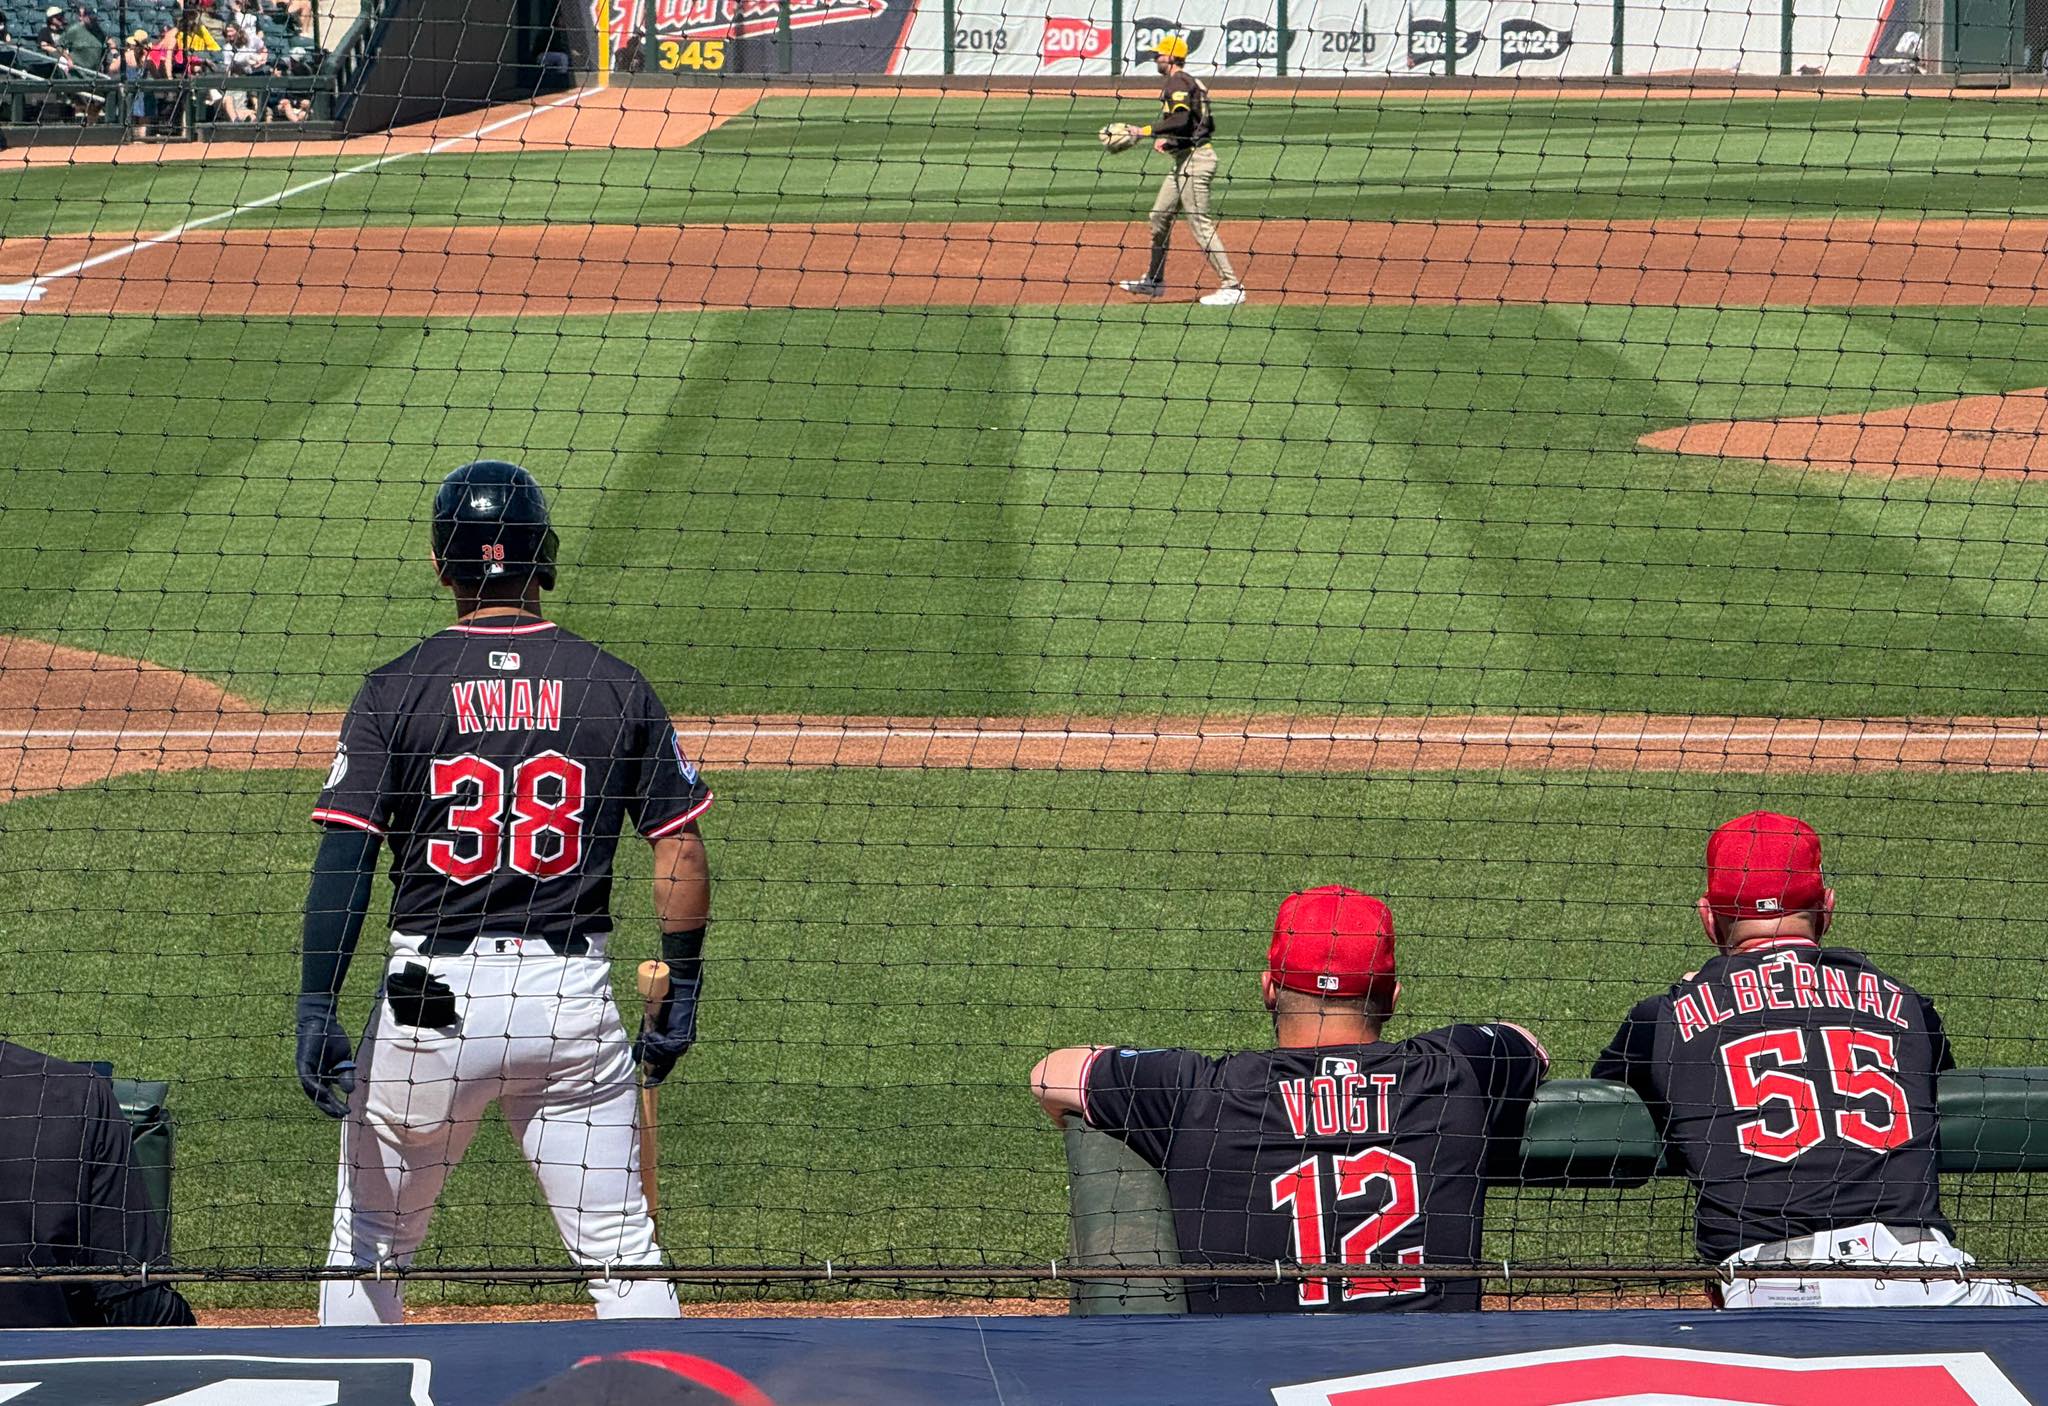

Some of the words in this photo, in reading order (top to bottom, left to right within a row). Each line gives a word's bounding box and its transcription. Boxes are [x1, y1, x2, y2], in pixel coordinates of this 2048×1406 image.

[956, 29, 1007, 50] 2013
[1048, 28, 1099, 51] 2016
[1136, 28, 1191, 51] 20
[1228, 30, 1279, 53] 2018
[1322, 32, 1376, 52] 2020
[1502, 31, 1560, 53] 2024
[658, 41, 725, 70] 345
[481, 544, 505, 561] 38
[451, 679, 563, 734] KWAN
[426, 749, 587, 887] 38
[1673, 961, 1909, 1043] ALBERNAZ
[1279, 1073, 1397, 1140] VOGT
[1719, 1026, 1914, 1164] 55
[1270, 1146, 1427, 1306] 12
